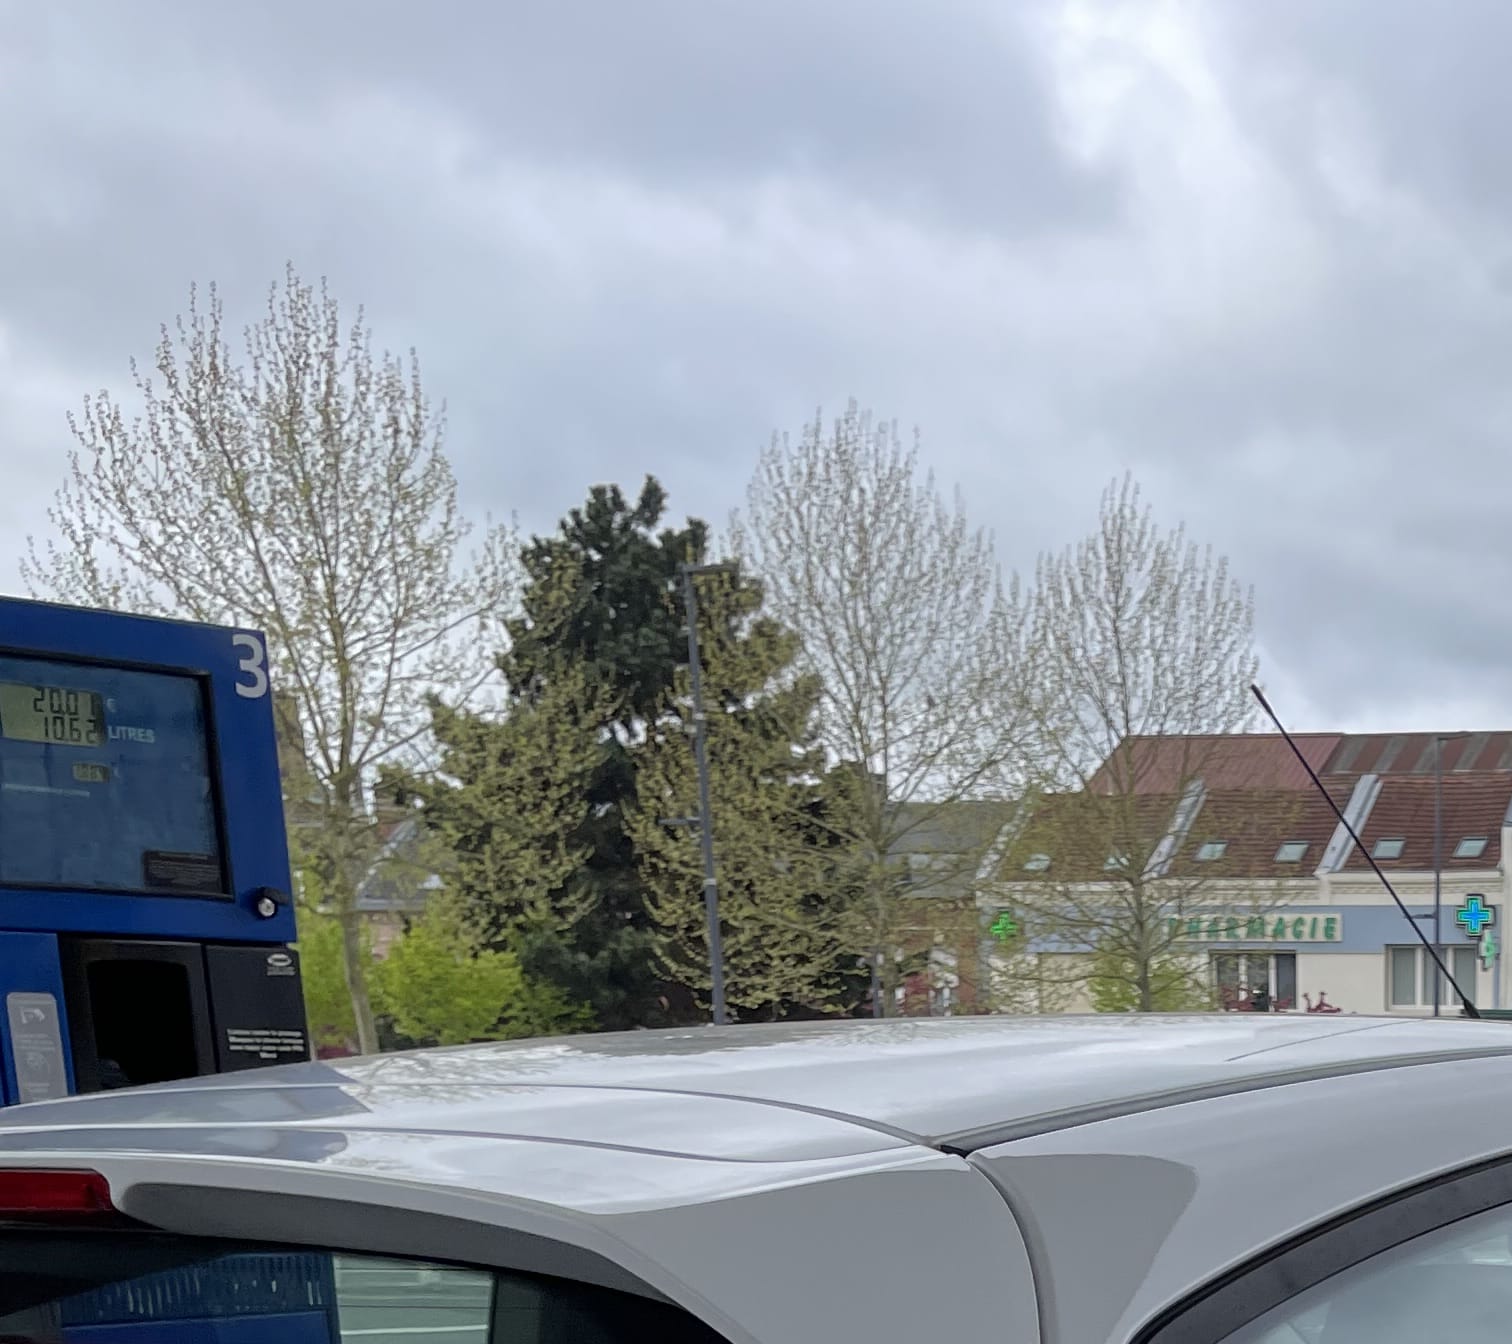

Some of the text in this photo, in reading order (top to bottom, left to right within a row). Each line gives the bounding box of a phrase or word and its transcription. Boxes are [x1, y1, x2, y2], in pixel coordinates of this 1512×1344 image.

[232, 633, 267, 698] 3
[107, 725, 155, 744] LITRES
[1166, 917, 1338, 940] PHARMACIE
